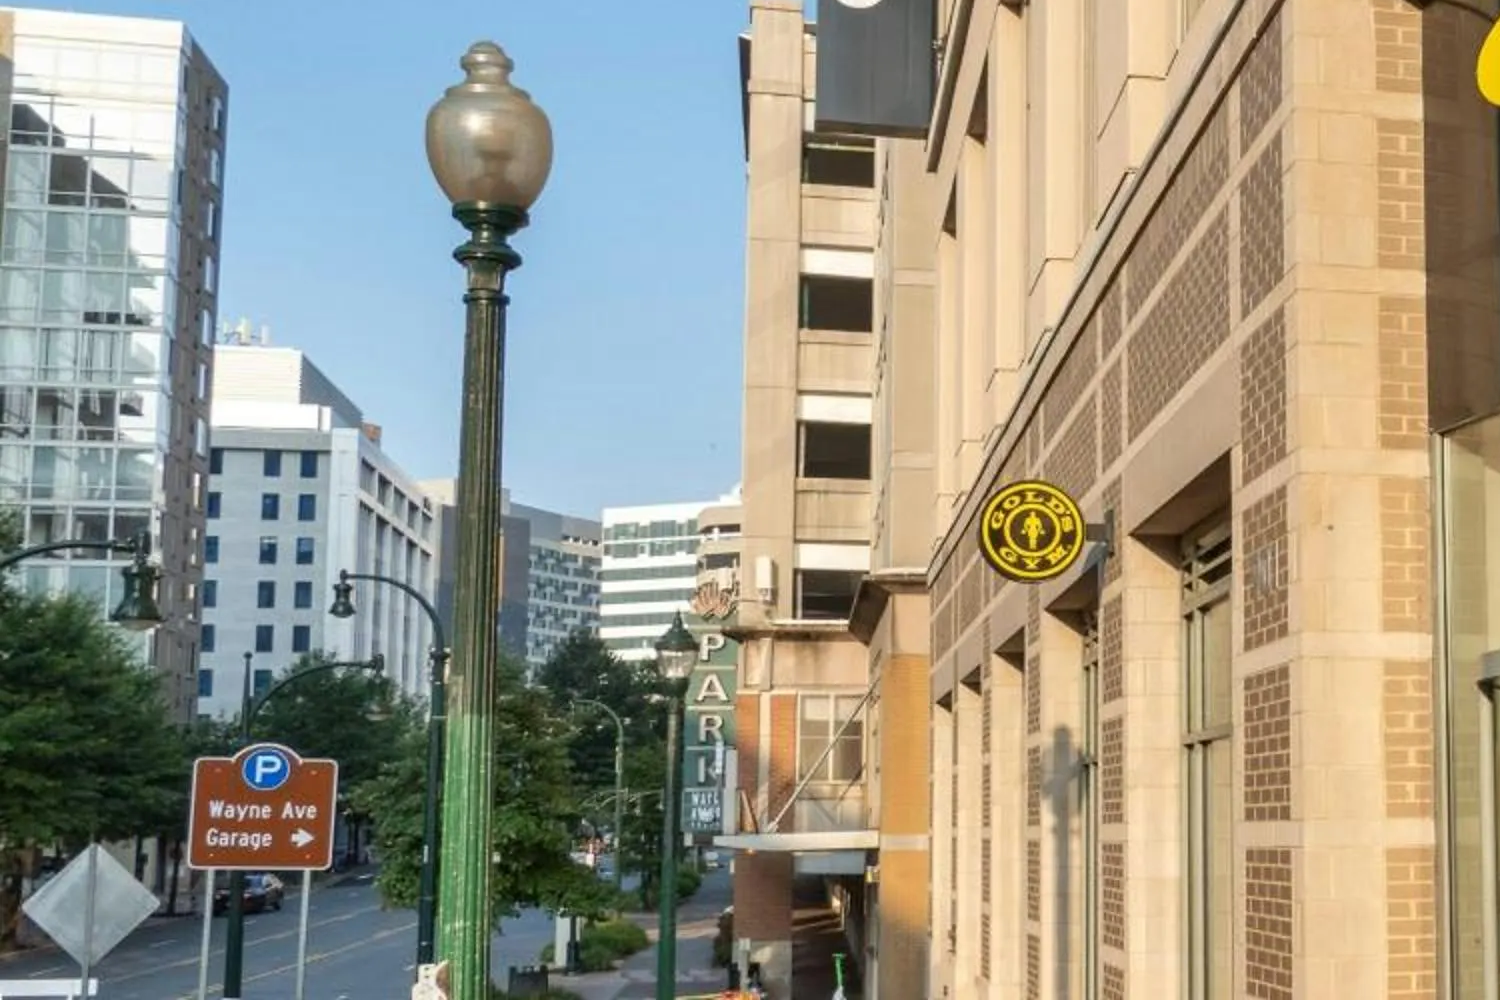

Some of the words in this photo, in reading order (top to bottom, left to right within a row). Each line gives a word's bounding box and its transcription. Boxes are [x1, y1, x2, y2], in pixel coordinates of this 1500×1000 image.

[991, 491, 1074, 532] GOLD'S
[999, 545, 1069, 570] GYM
[254, 755, 283, 784] P
[209, 800, 272, 822] Wayne
[281, 801, 317, 820] Ave
[206, 827, 273, 850] Garage
